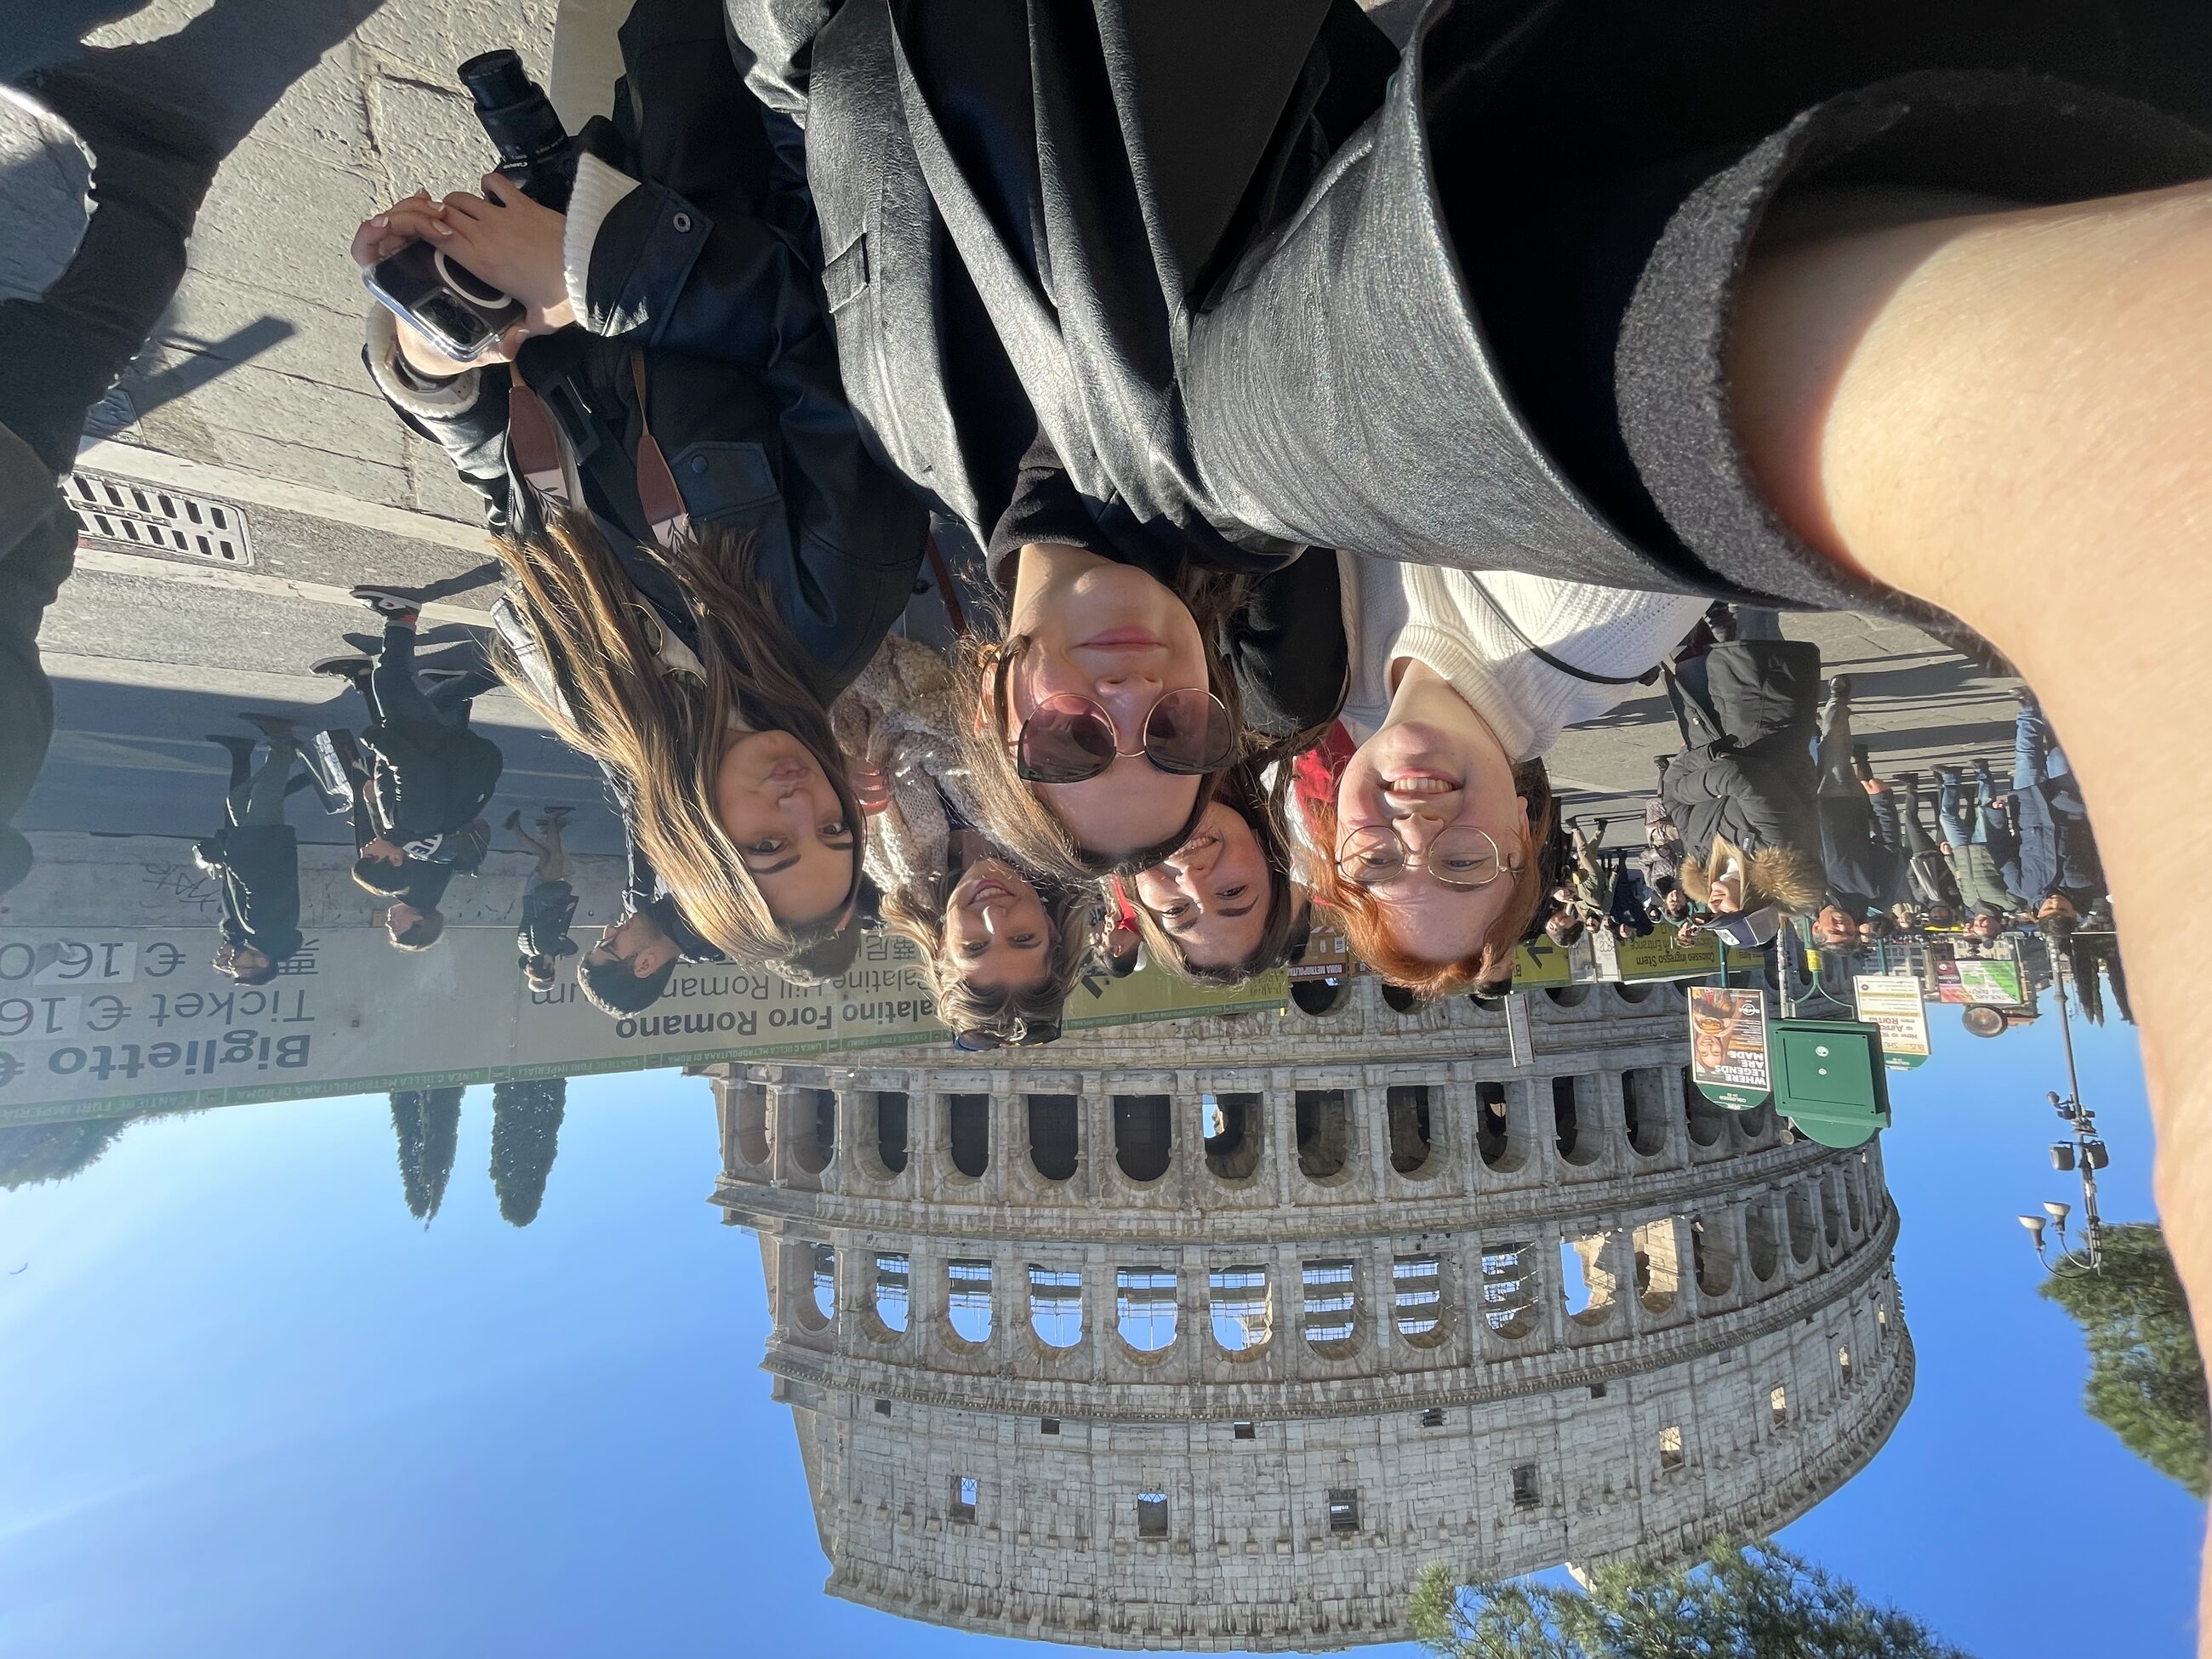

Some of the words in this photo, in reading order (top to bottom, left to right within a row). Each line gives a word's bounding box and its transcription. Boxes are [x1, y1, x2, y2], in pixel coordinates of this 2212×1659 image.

[77, 501, 167, 524] SPQR
[1630, 938, 1662, 951] Entrance
[145, 942, 186, 978] €
[1636, 955, 1657, 967] Stern
[1658, 950, 1687, 965] ingresso
[1687, 951, 1715, 963] Colosseo
[1325, 964, 1343, 974] ROMA
[87, 995, 132, 1032] €
[149, 989, 315, 1027] Ticket
[842, 999, 933, 1025] alatino
[768, 1006, 832, 1030] Foro
[615, 1011, 757, 1039] Romano
[704, 1047, 769, 1061] METROPOLITANA
[801, 1043, 822, 1052] LINEA
[48, 1029, 311, 1080] Biglietto
[667, 1053, 693, 1063] ROMA
[693, 1053, 702, 1062] DI
[518, 1064, 568, 1076] IMPERIALI
[570, 1062, 592, 1072] FORI
[593, 1058, 638, 1070] CANTIERE
[1713, 1064, 1765, 1077] LEGENDS
[1741, 1059, 1764, 1069] ARE
[399, 1075, 435, 1086] DELLA
[436, 1074, 445, 1083] C
[448, 1071, 480, 1082] LINEA
[1725, 1073, 1766, 1086] WHERE
[236, 1086, 274, 1098] ROMA
[278, 1086, 292, 1096] DI
[295, 1077, 397, 1095] METROPOLITANA
[79, 1100, 111, 1114] FORI
[117, 1091, 187, 1110] CANTIERE
